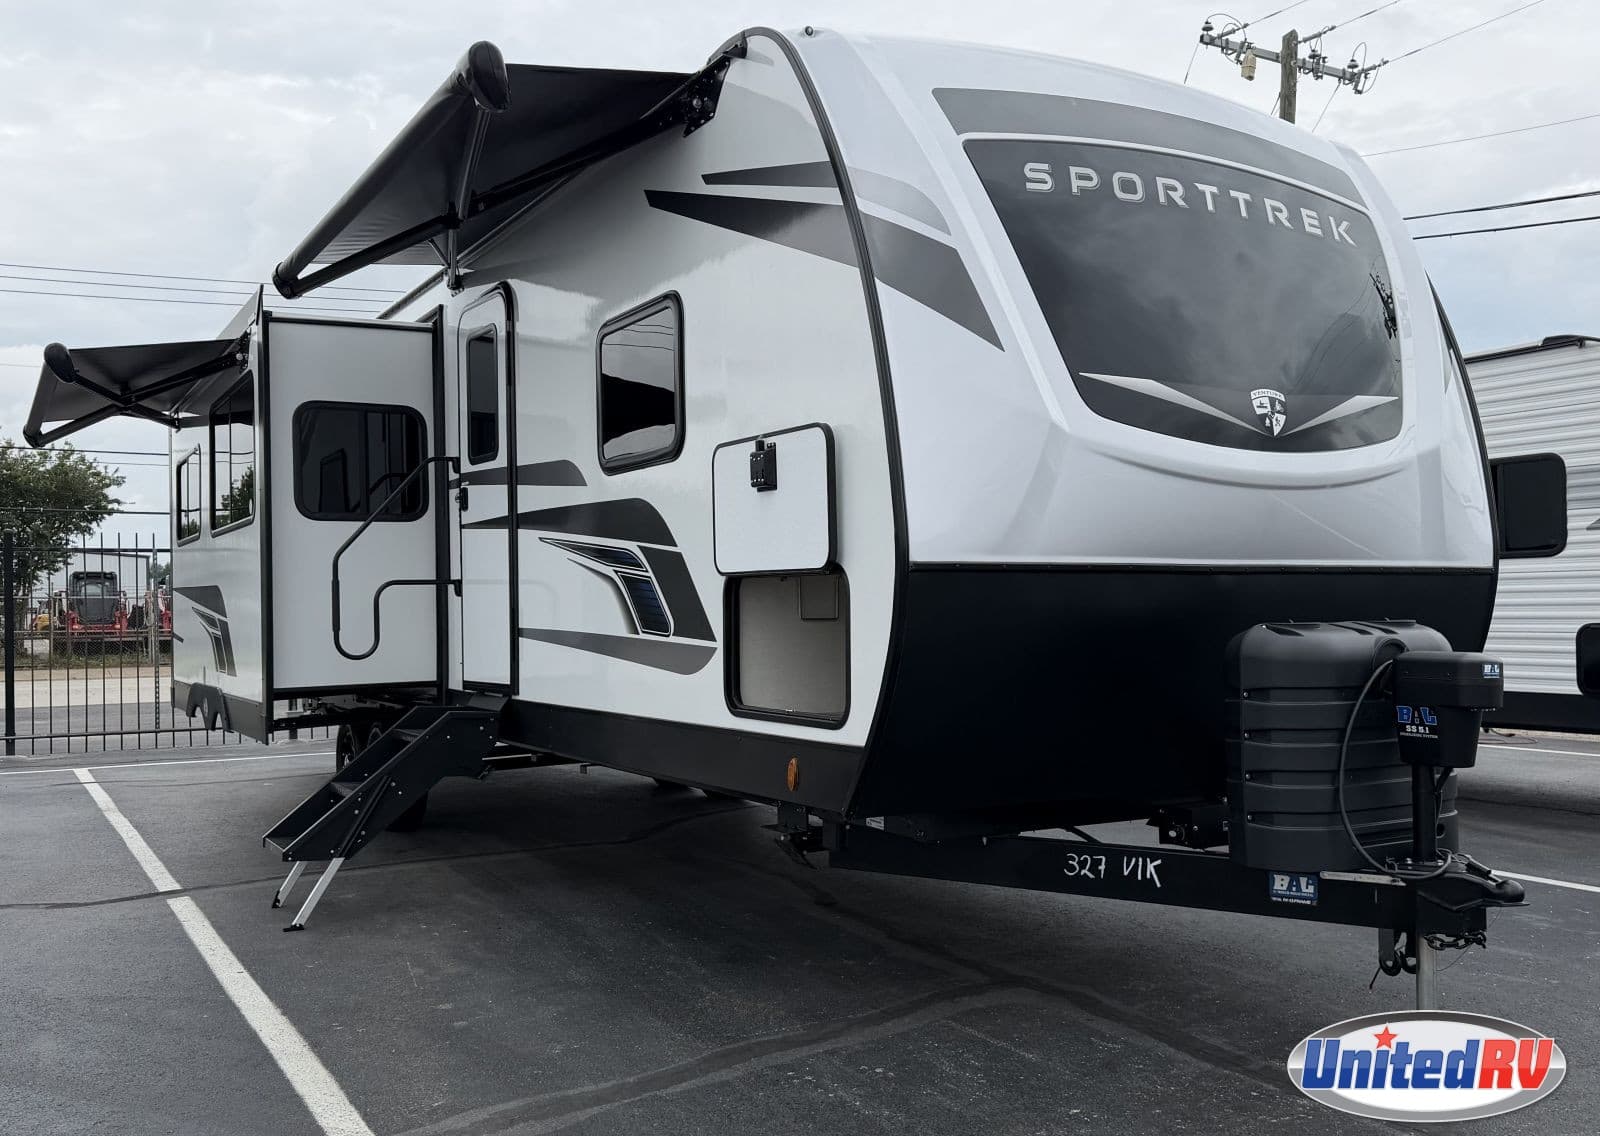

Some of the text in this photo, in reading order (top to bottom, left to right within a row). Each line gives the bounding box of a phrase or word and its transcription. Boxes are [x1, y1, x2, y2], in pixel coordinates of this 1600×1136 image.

[1023, 162, 1357, 247] SPORTTREK
[1395, 705, 1438, 726] BAL
[1405, 725, 1418, 733] SS
[1063, 853, 1162, 888] 327 VIK
[1273, 874, 1315, 893] BAL
